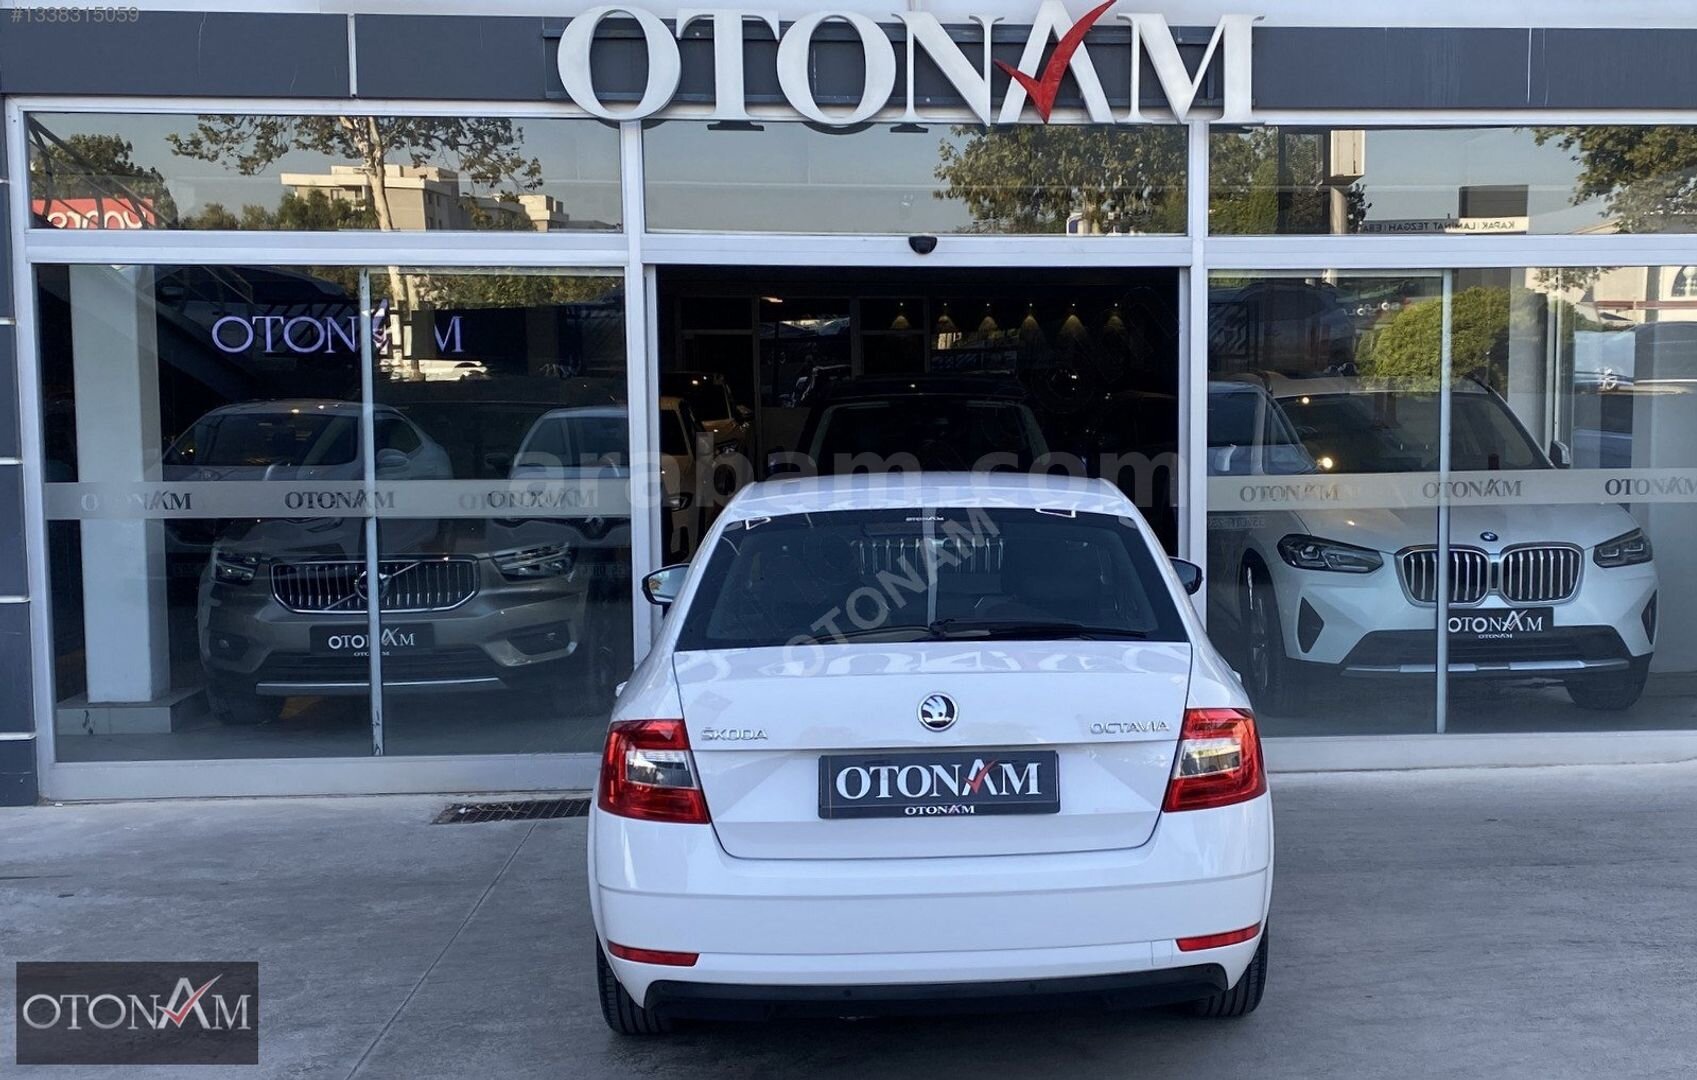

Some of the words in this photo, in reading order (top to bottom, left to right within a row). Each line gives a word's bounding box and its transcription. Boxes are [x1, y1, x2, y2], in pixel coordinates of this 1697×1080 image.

[557, 0, 1264, 126] OTONAM
[284, 489, 395, 510] OTONAM
[1448, 610, 1543, 633] OTONAM
[328, 627, 416, 649] OTOAM
[1090, 720, 1170, 735] OCTAVIA
[835, 758, 1043, 800] OTONAM
[904, 803, 976, 815] OTONAM
